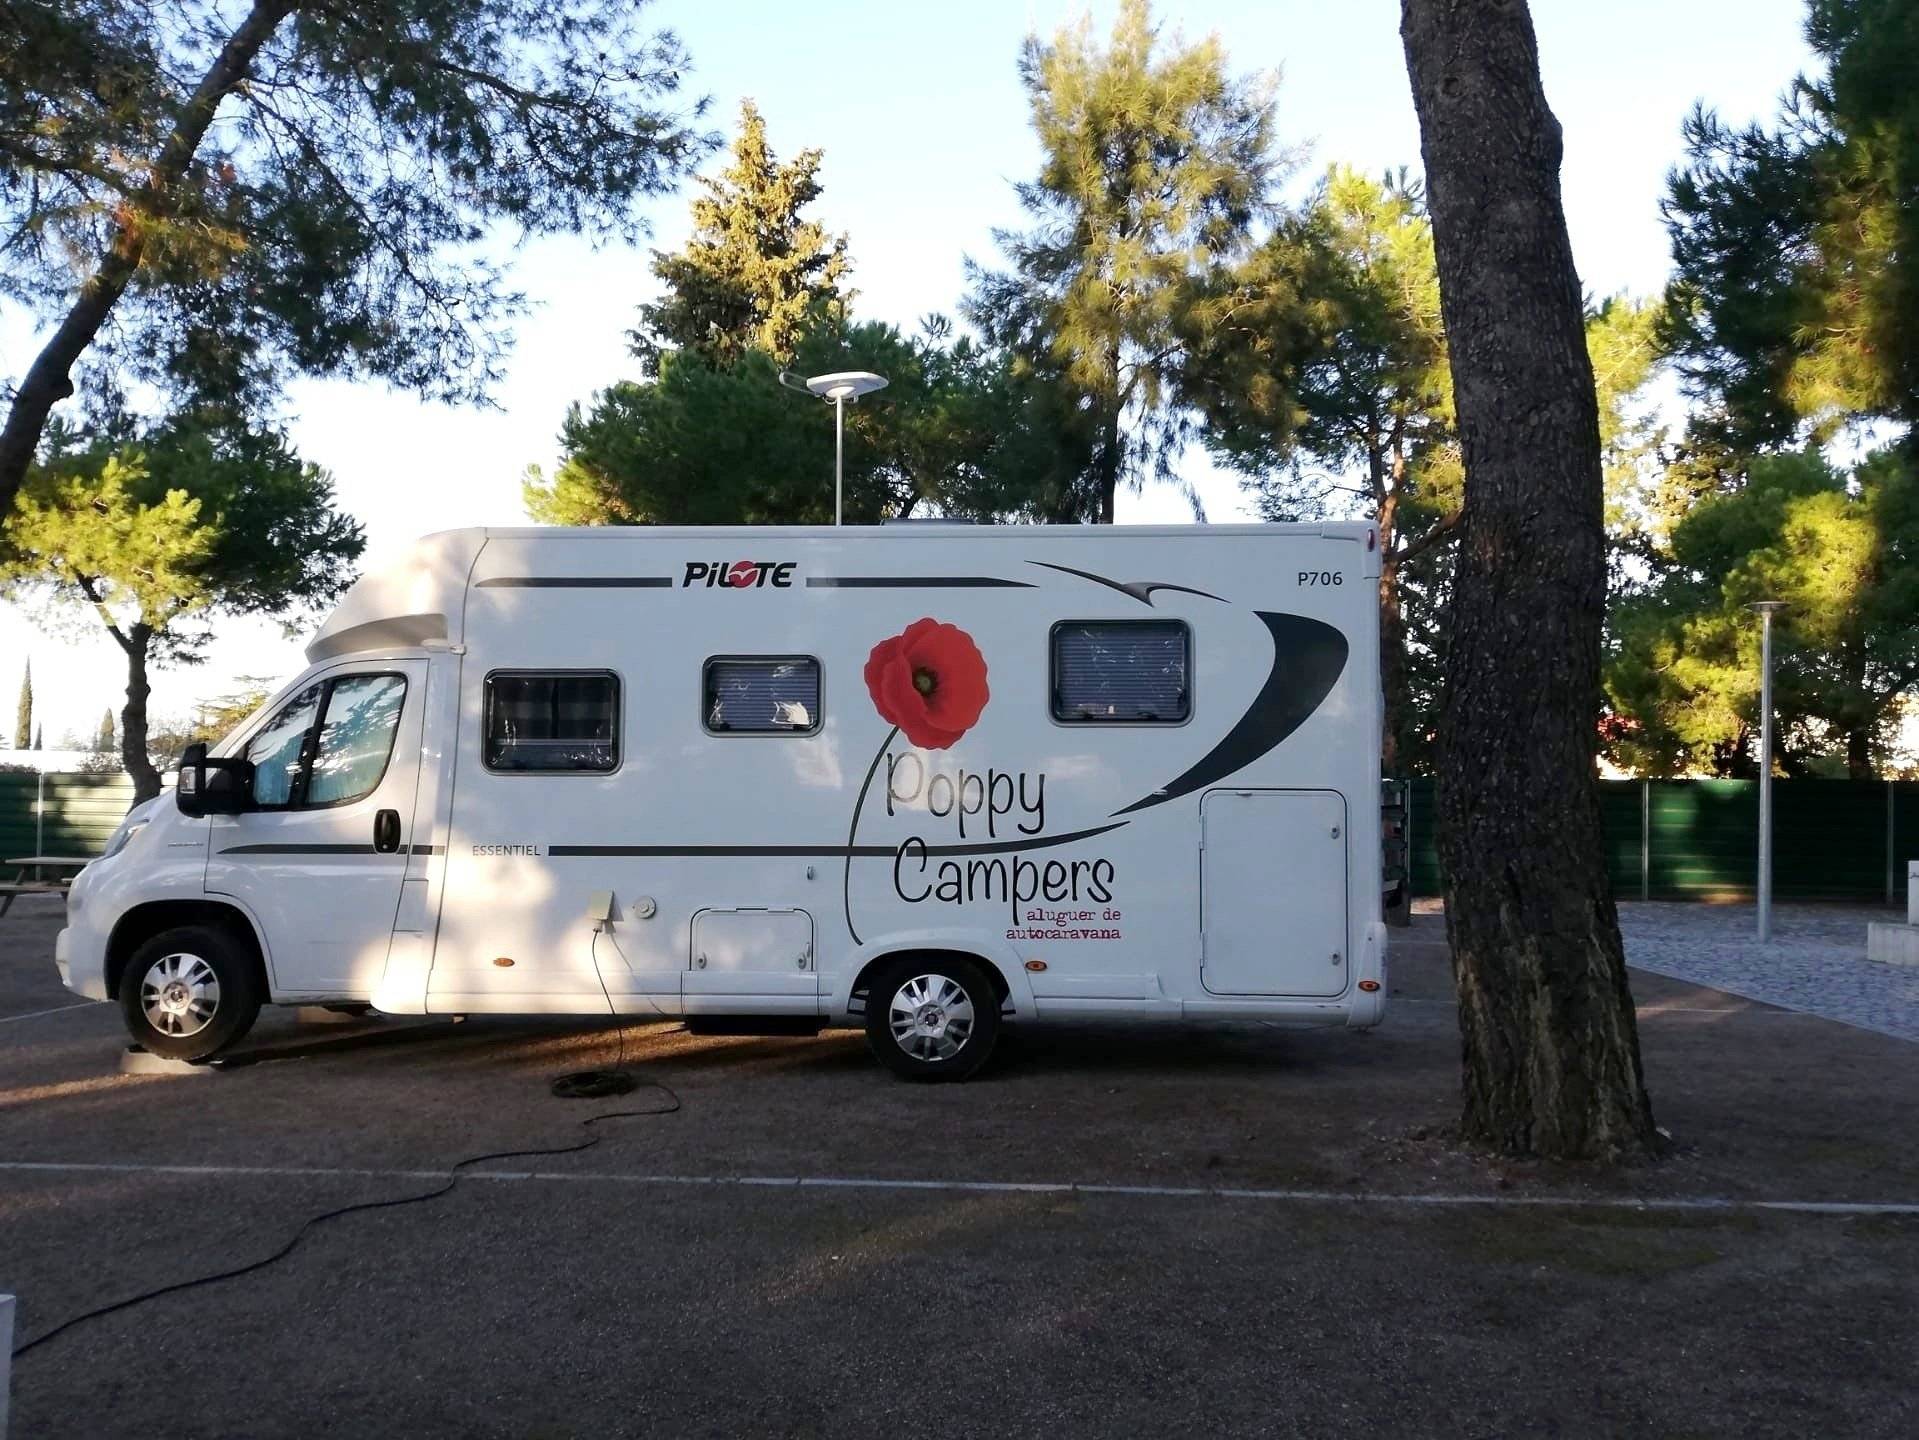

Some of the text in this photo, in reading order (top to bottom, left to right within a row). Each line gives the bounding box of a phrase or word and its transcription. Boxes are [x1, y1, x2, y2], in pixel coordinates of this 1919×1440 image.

[1298, 571, 1343, 586] P706
[886, 751, 1046, 838] Poppy
[472, 845, 541, 856] ESSENTIEL
[894, 836, 1115, 926] Campers
[1026, 908, 1121, 927] aluguer de
[1005, 926, 1121, 939] autocaravana
